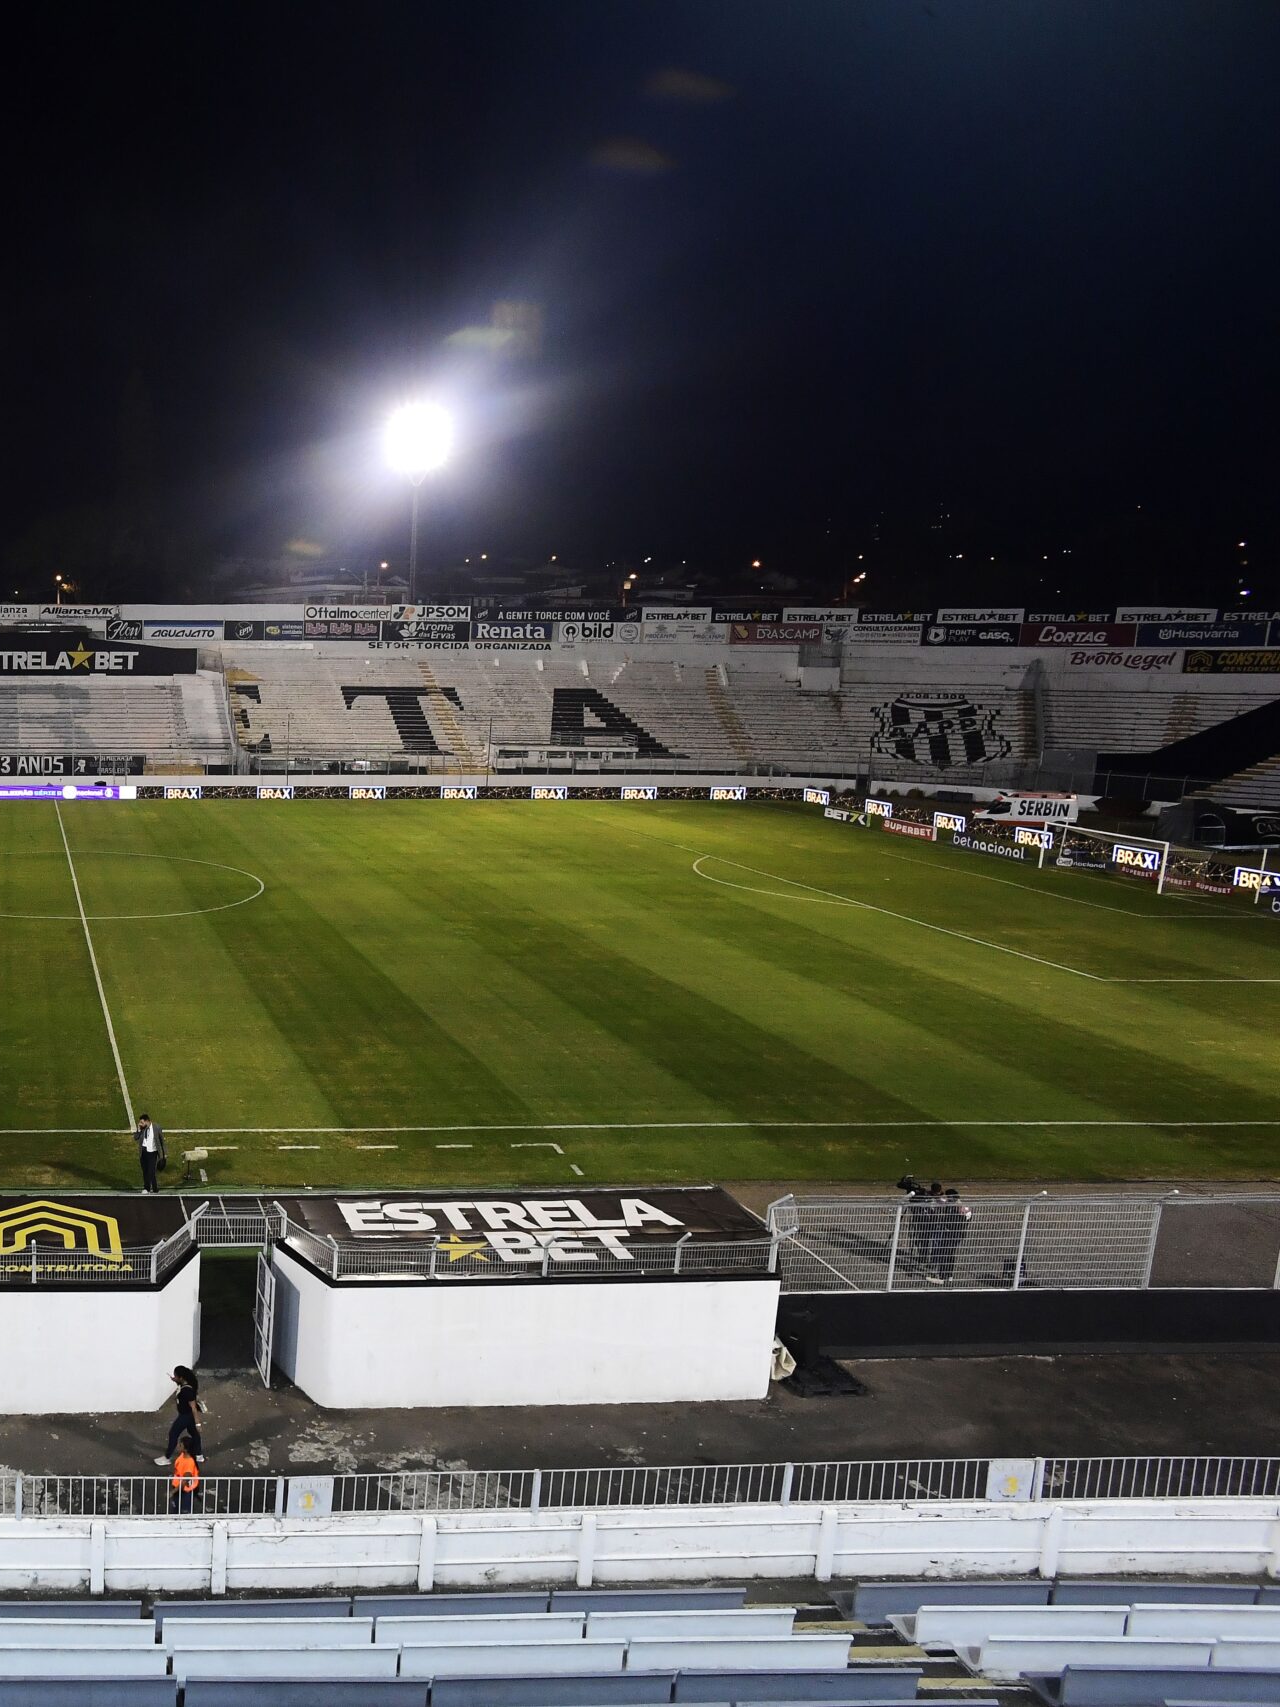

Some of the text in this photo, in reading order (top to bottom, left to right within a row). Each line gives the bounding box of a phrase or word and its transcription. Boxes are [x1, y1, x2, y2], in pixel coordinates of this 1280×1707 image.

[306, 606, 390, 619] Oftalmocenter
[417, 607, 469, 618] JPSOM
[498, 610, 610, 620] A GENTE TORCE COM VOCÊ
[715, 613, 778, 621] ESTRELA BET
[915, 613, 932, 621] BET
[1186, 613, 1211, 621] BET
[151, 629, 214, 637] AGUAJATO
[417, 622, 454, 631] Aroma
[477, 623, 545, 639] Renata
[581, 623, 614, 638] bild
[430, 631, 455, 640] Ervas
[1038, 626, 1108, 642] CORTAG
[1172, 629, 1239, 641] Husqvarna
[475, 643, 551, 651] ORGANIZADA
[95, 652, 138, 670] BET
[1071, 652, 1177, 671] Broto Legal
[18, 756, 64, 774] ANOS
[166, 789, 199, 799] BRAX
[260, 788, 291, 799] BRAX
[352, 788, 382, 799] BRAX
[444, 788, 474, 799] BRAX
[534, 788, 564, 799] BRAX
[624, 788, 654, 799] BRAX
[714, 788, 743, 799] BRAX
[806, 791, 827, 805] BRAX
[868, 802, 889, 817] BRAX
[1018, 799, 1069, 817] SERBIN
[824, 807, 866, 825] BET7K
[884, 818, 932, 837] SUPERBET
[936, 816, 963, 832] BRAX
[953, 833, 1024, 859] bet nacional
[1019, 832, 1049, 849] BRAX
[1117, 850, 1155, 869] BRAX
[337, 1198, 685, 1232] ESTRELA
[483, 1229, 635, 1263] BET
